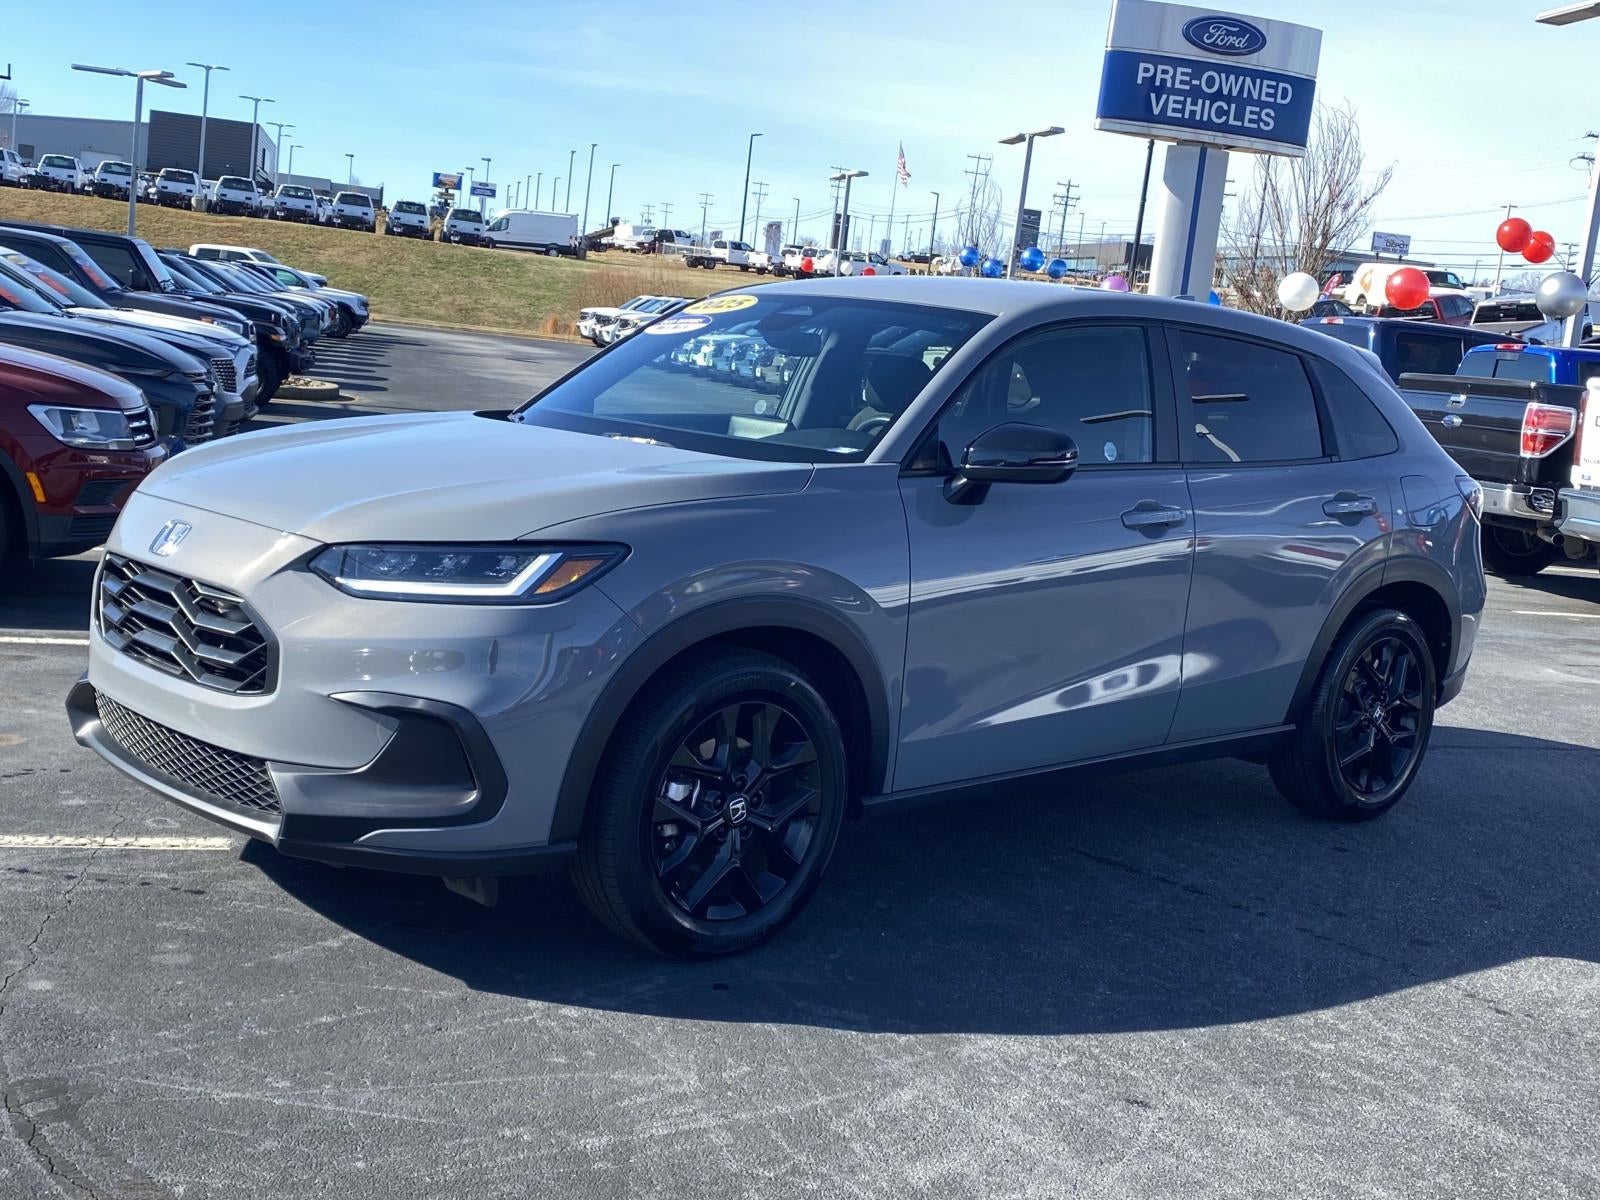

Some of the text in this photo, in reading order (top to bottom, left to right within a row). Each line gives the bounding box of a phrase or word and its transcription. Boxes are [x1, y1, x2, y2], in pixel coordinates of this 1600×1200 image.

[1203, 23, 1250, 49] Ford
[1136, 62, 1293, 105] PRE-OWNED
[1150, 92, 1276, 131] VEHICLES
